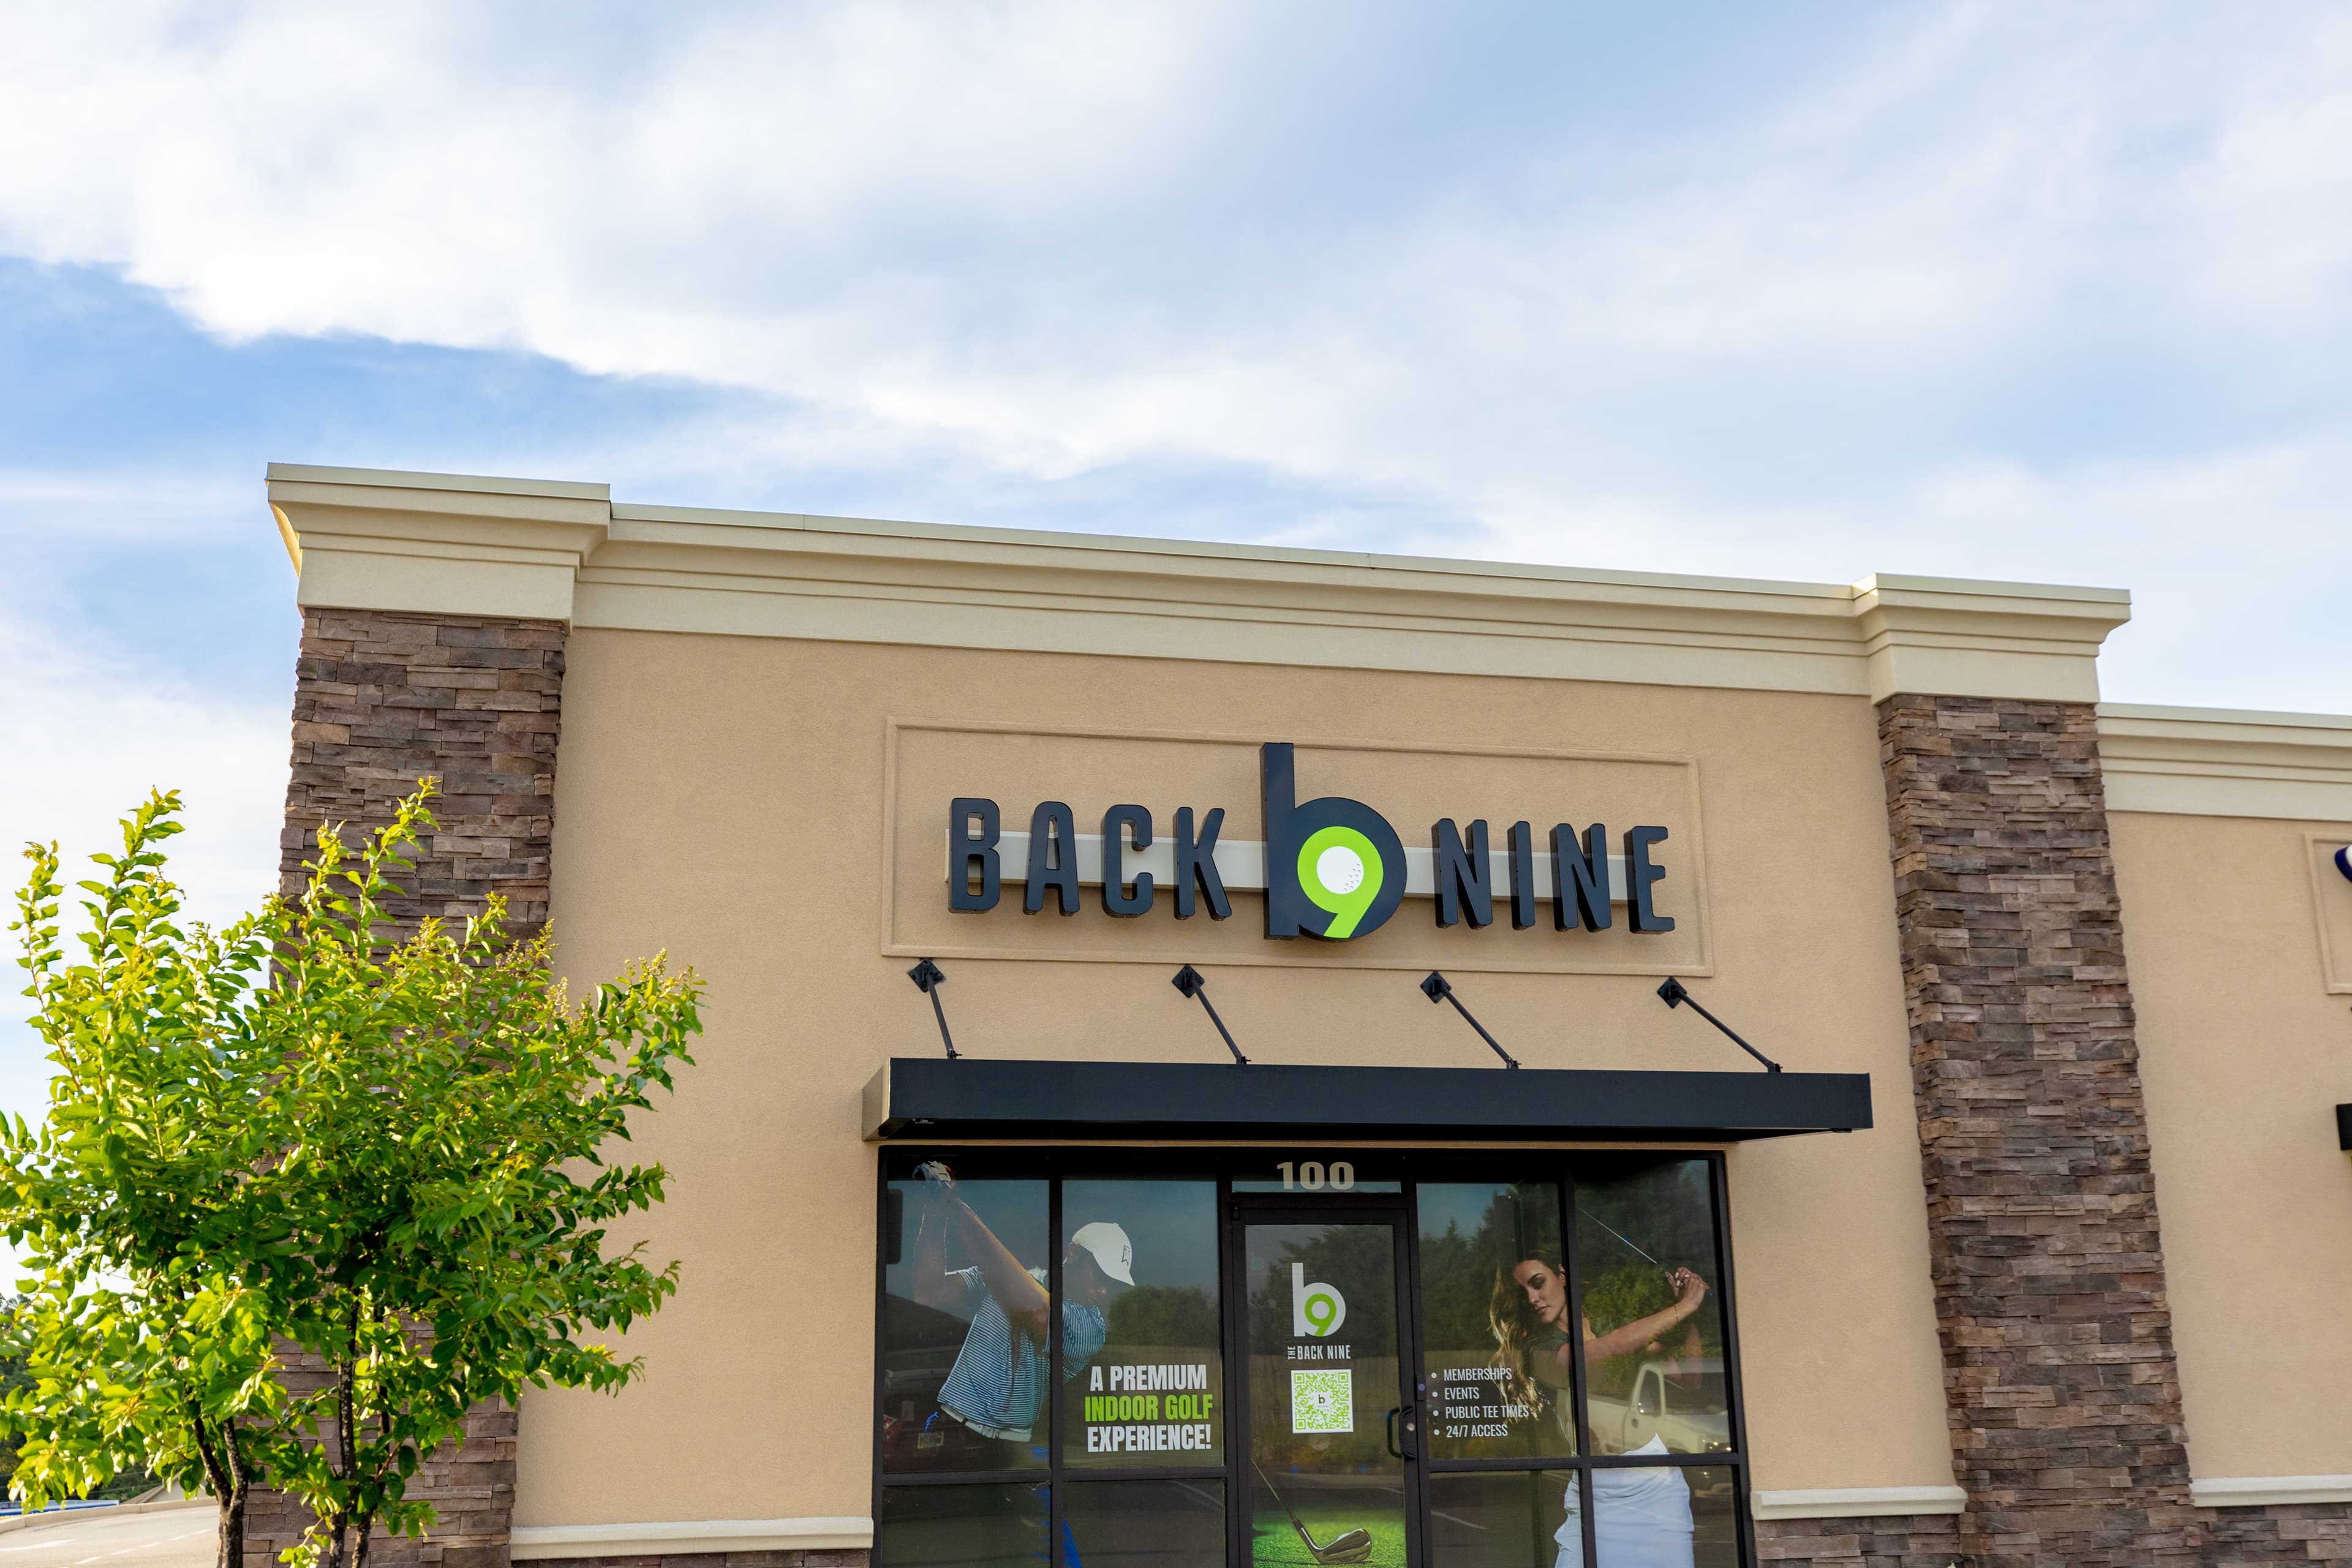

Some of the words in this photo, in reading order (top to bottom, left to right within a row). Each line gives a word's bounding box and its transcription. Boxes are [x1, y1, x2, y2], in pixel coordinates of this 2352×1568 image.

[949, 797, 1232, 920] BACK
[1432, 818, 1675, 933] NINE
[1277, 1162, 1354, 1189] 100
[1297, 1345, 1324, 1360] BACK
[1327, 1344, 1351, 1359] NINE
[1090, 1366, 1103, 1391] A
[1110, 1365, 1207, 1391] PREMIUM
[1444, 1368, 1512, 1381] MEMBERSHIPS
[1444, 1387, 1480, 1400] EVENTS
[1085, 1395, 1159, 1422] INDOOR
[1165, 1394, 1213, 1420] GOLF
[1446, 1406, 1480, 1419] PUBLIC
[1482, 1406, 1499, 1418] TEE
[1501, 1405, 1529, 1417] TIMES
[1087, 1424, 1212, 1452] EXPERIENCE!
[1446, 1425, 1468, 1438] 24/7
[1471, 1424, 1508, 1437] ACCESS
